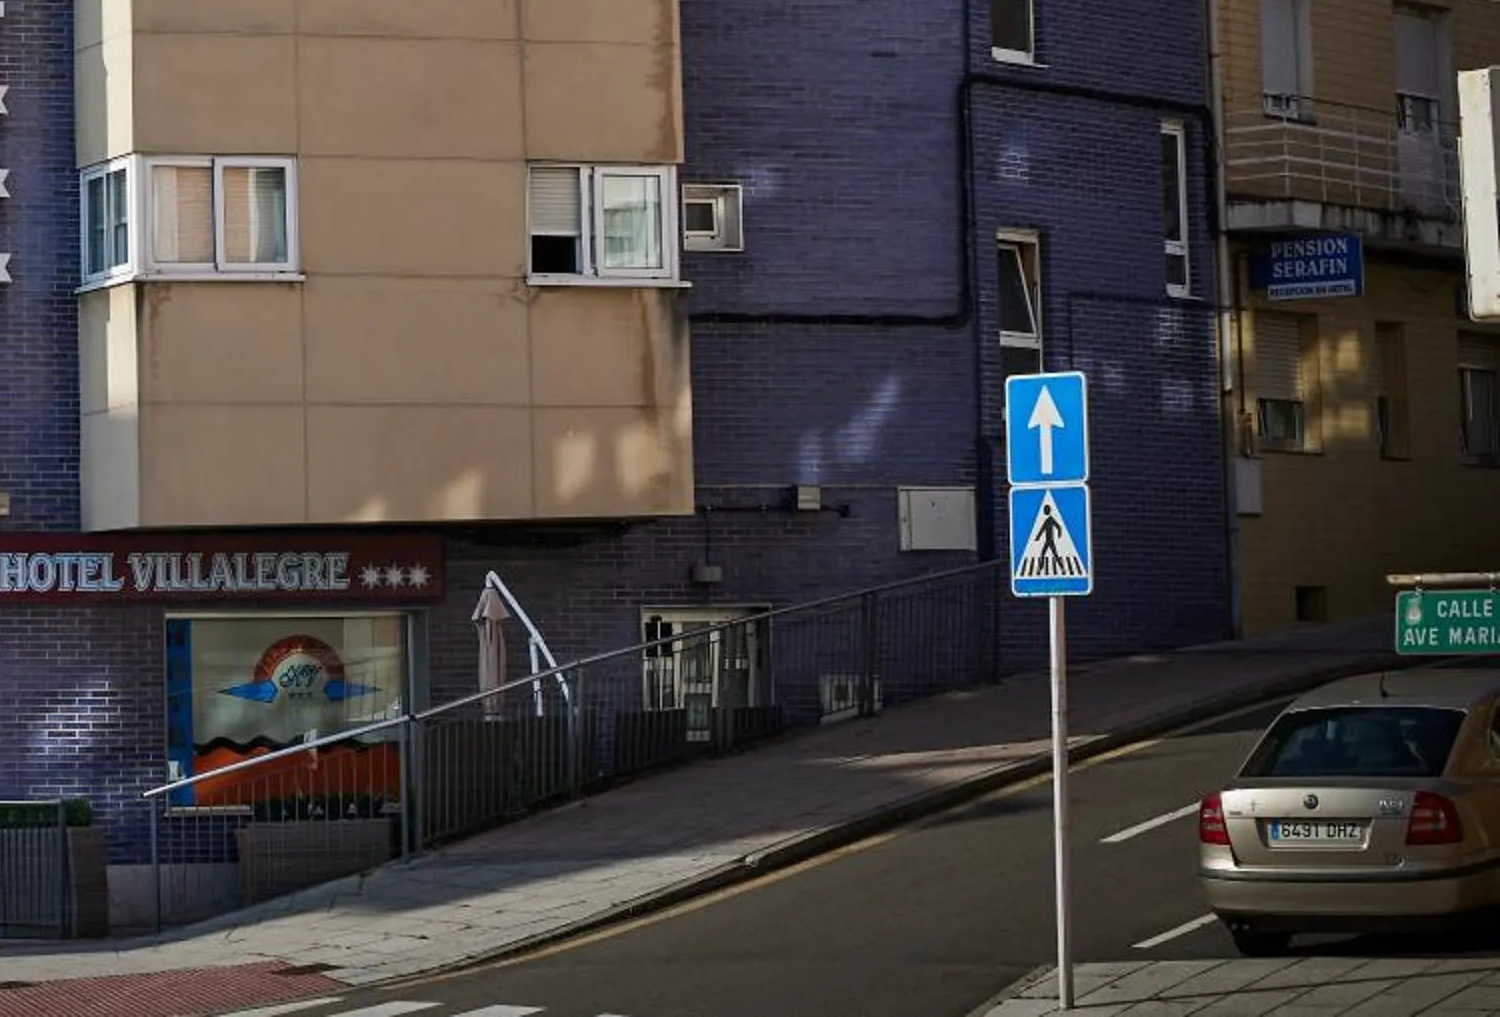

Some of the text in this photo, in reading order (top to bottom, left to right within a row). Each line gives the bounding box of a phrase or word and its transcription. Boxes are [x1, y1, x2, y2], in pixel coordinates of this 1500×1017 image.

[1270, 238, 1348, 259] PENSION
[1272, 258, 1347, 279] SERAFIN
[127, 551, 352, 591] VILLALEGRE
[1437, 599, 1493, 618] CALLE
[1403, 626, 1500, 646] AVE MARI
[1327, 822, 1357, 838] DHZ
